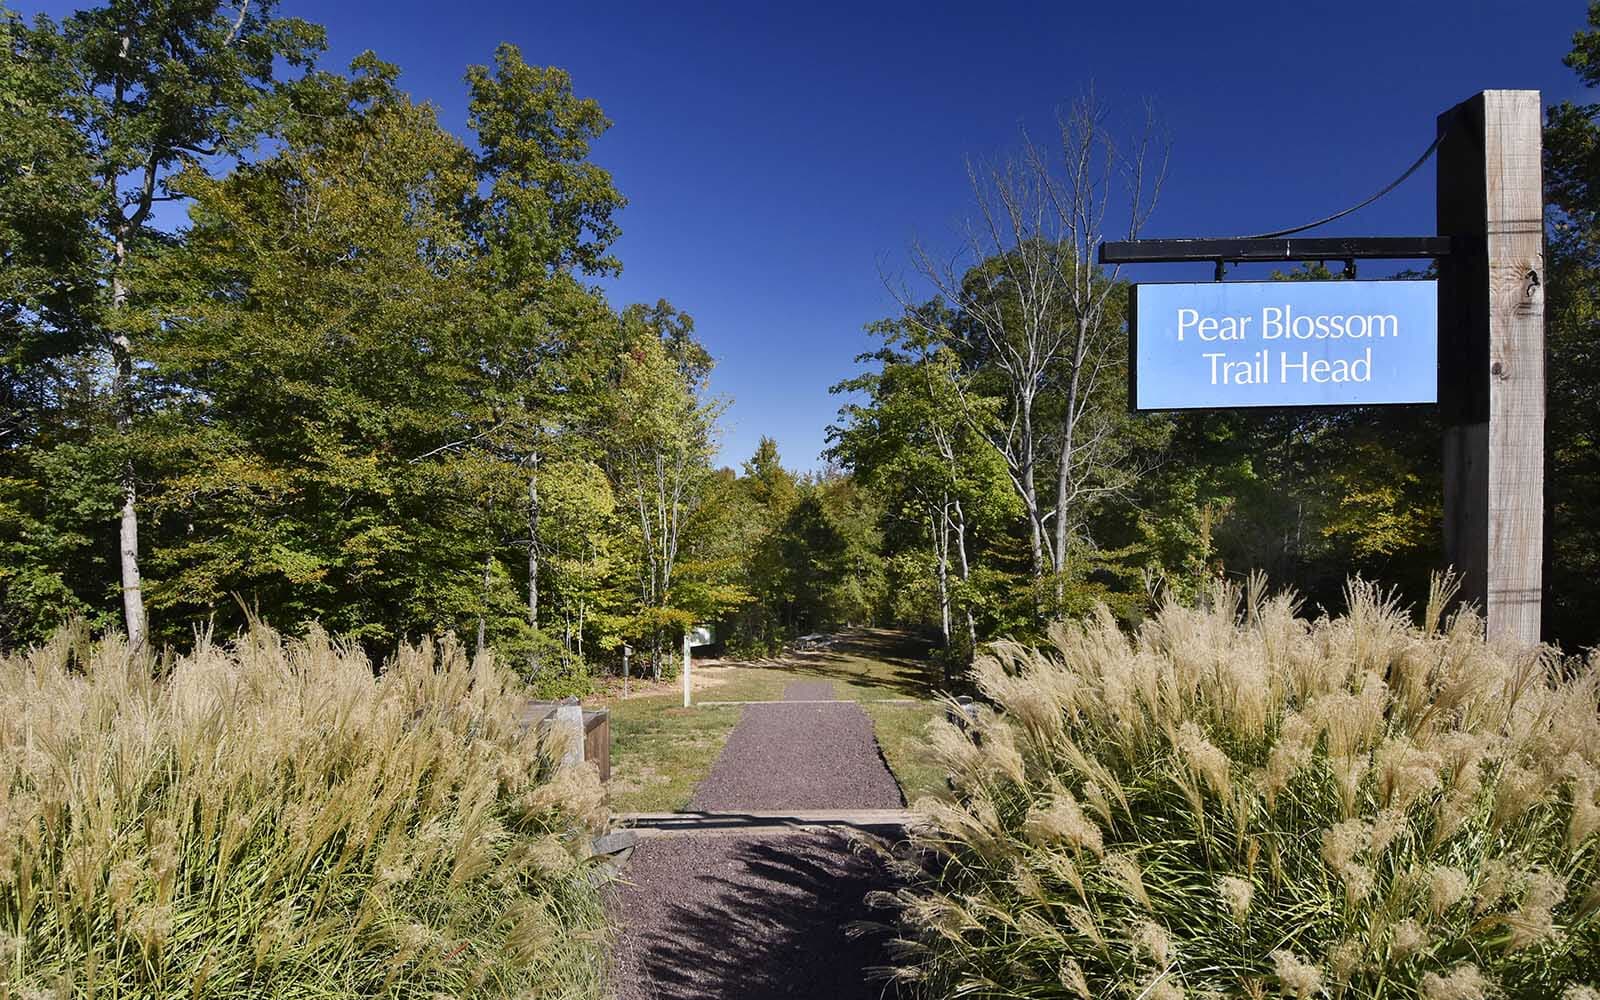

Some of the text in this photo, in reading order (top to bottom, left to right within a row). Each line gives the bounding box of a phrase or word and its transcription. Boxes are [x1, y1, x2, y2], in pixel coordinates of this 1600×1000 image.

[1177, 304, 1398, 341] Pear Blossom
[1202, 347, 1372, 385] Trail Head
